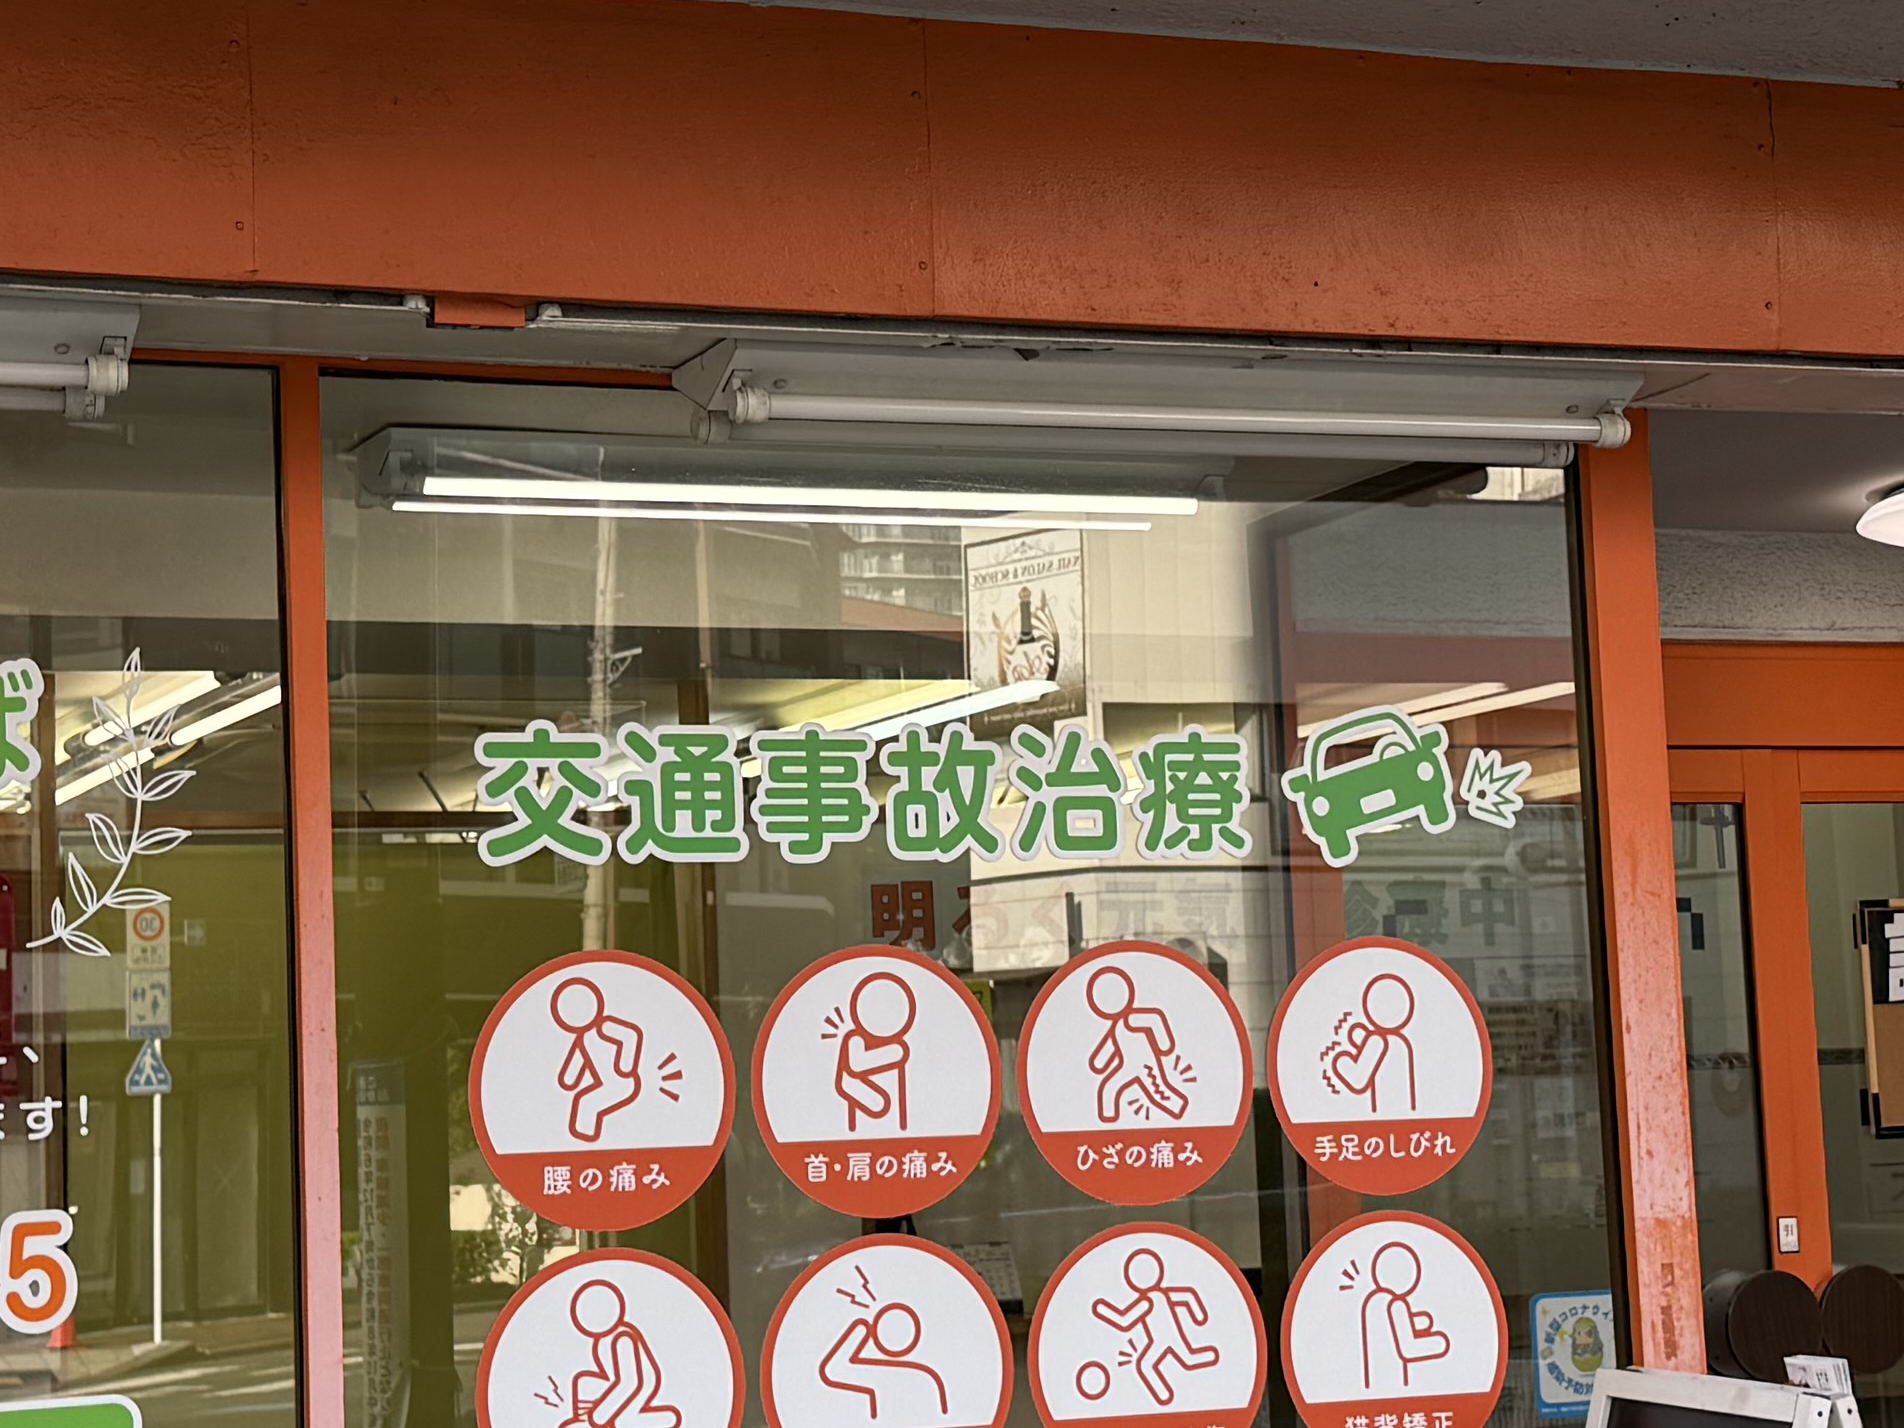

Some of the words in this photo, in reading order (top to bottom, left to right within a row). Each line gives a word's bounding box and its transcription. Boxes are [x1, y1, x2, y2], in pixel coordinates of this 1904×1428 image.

[476, 718, 1253, 868] 交通事故治療
[1074, 1139, 1205, 1171] ひざの痛み
[1312, 1131, 1458, 1162] 手足のしびれ
[542, 1162, 672, 1197] 腰の痛み
[803, 1151, 959, 1183] 首・肩の痛み
